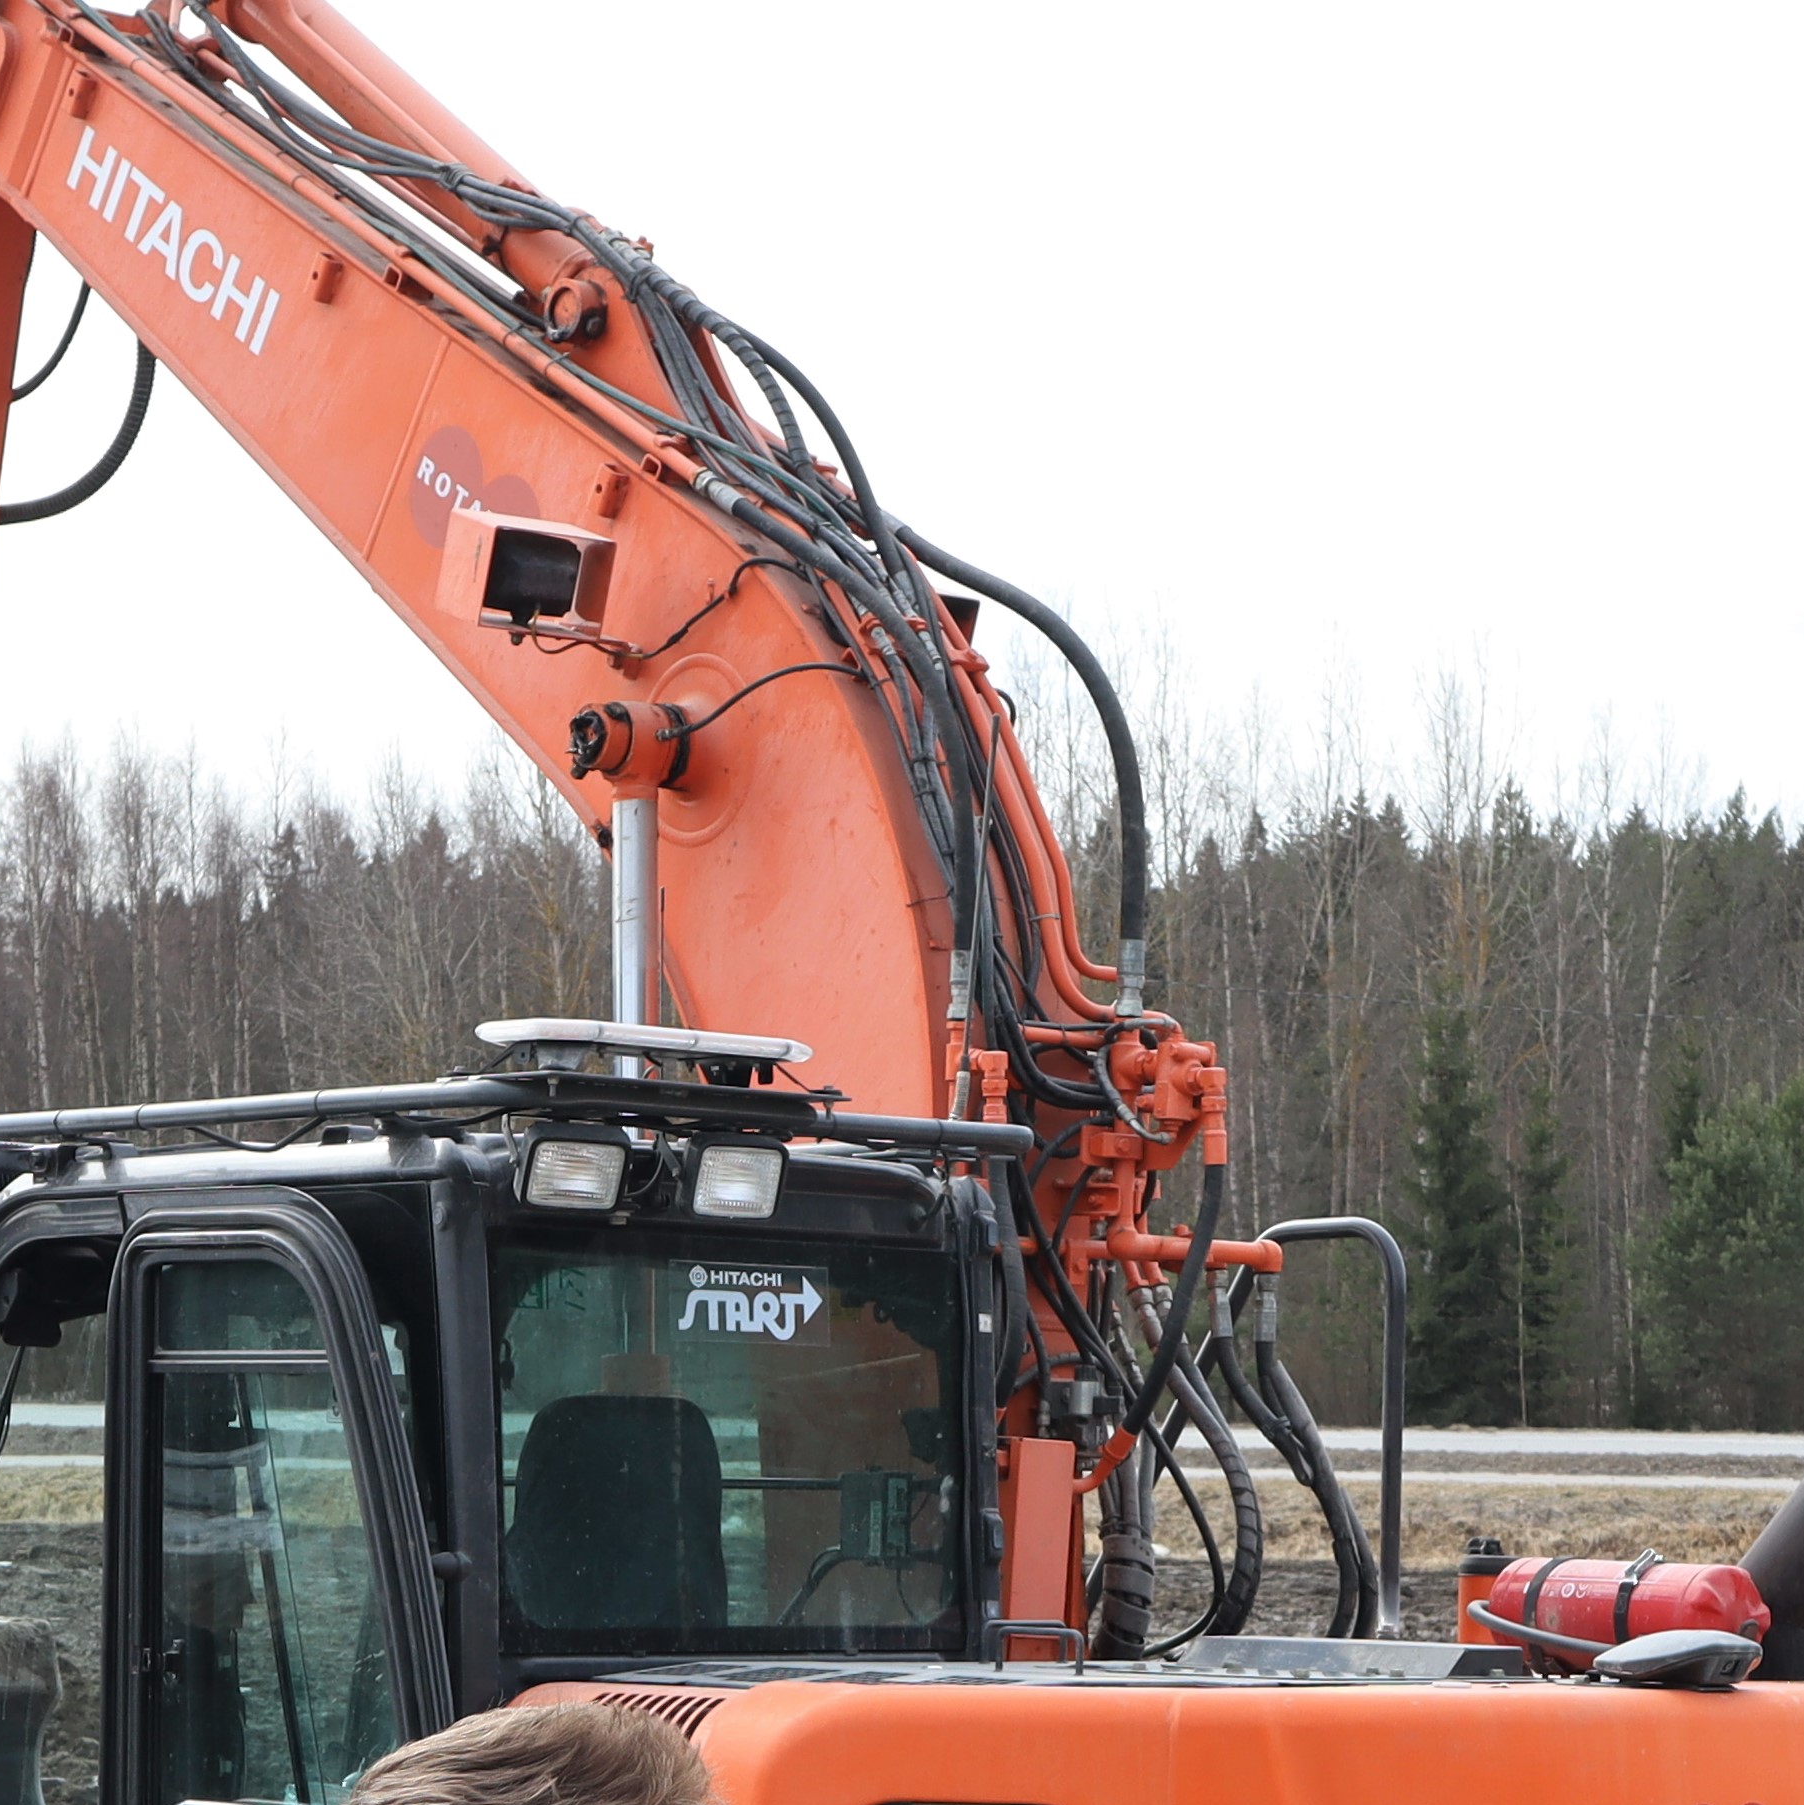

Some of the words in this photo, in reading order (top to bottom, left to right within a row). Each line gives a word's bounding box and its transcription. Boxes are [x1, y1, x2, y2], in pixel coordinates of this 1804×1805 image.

[66, 125, 281, 356] HITACHI
[710, 1270, 783, 1287] HITACHI
[678, 1288, 823, 1341] START
